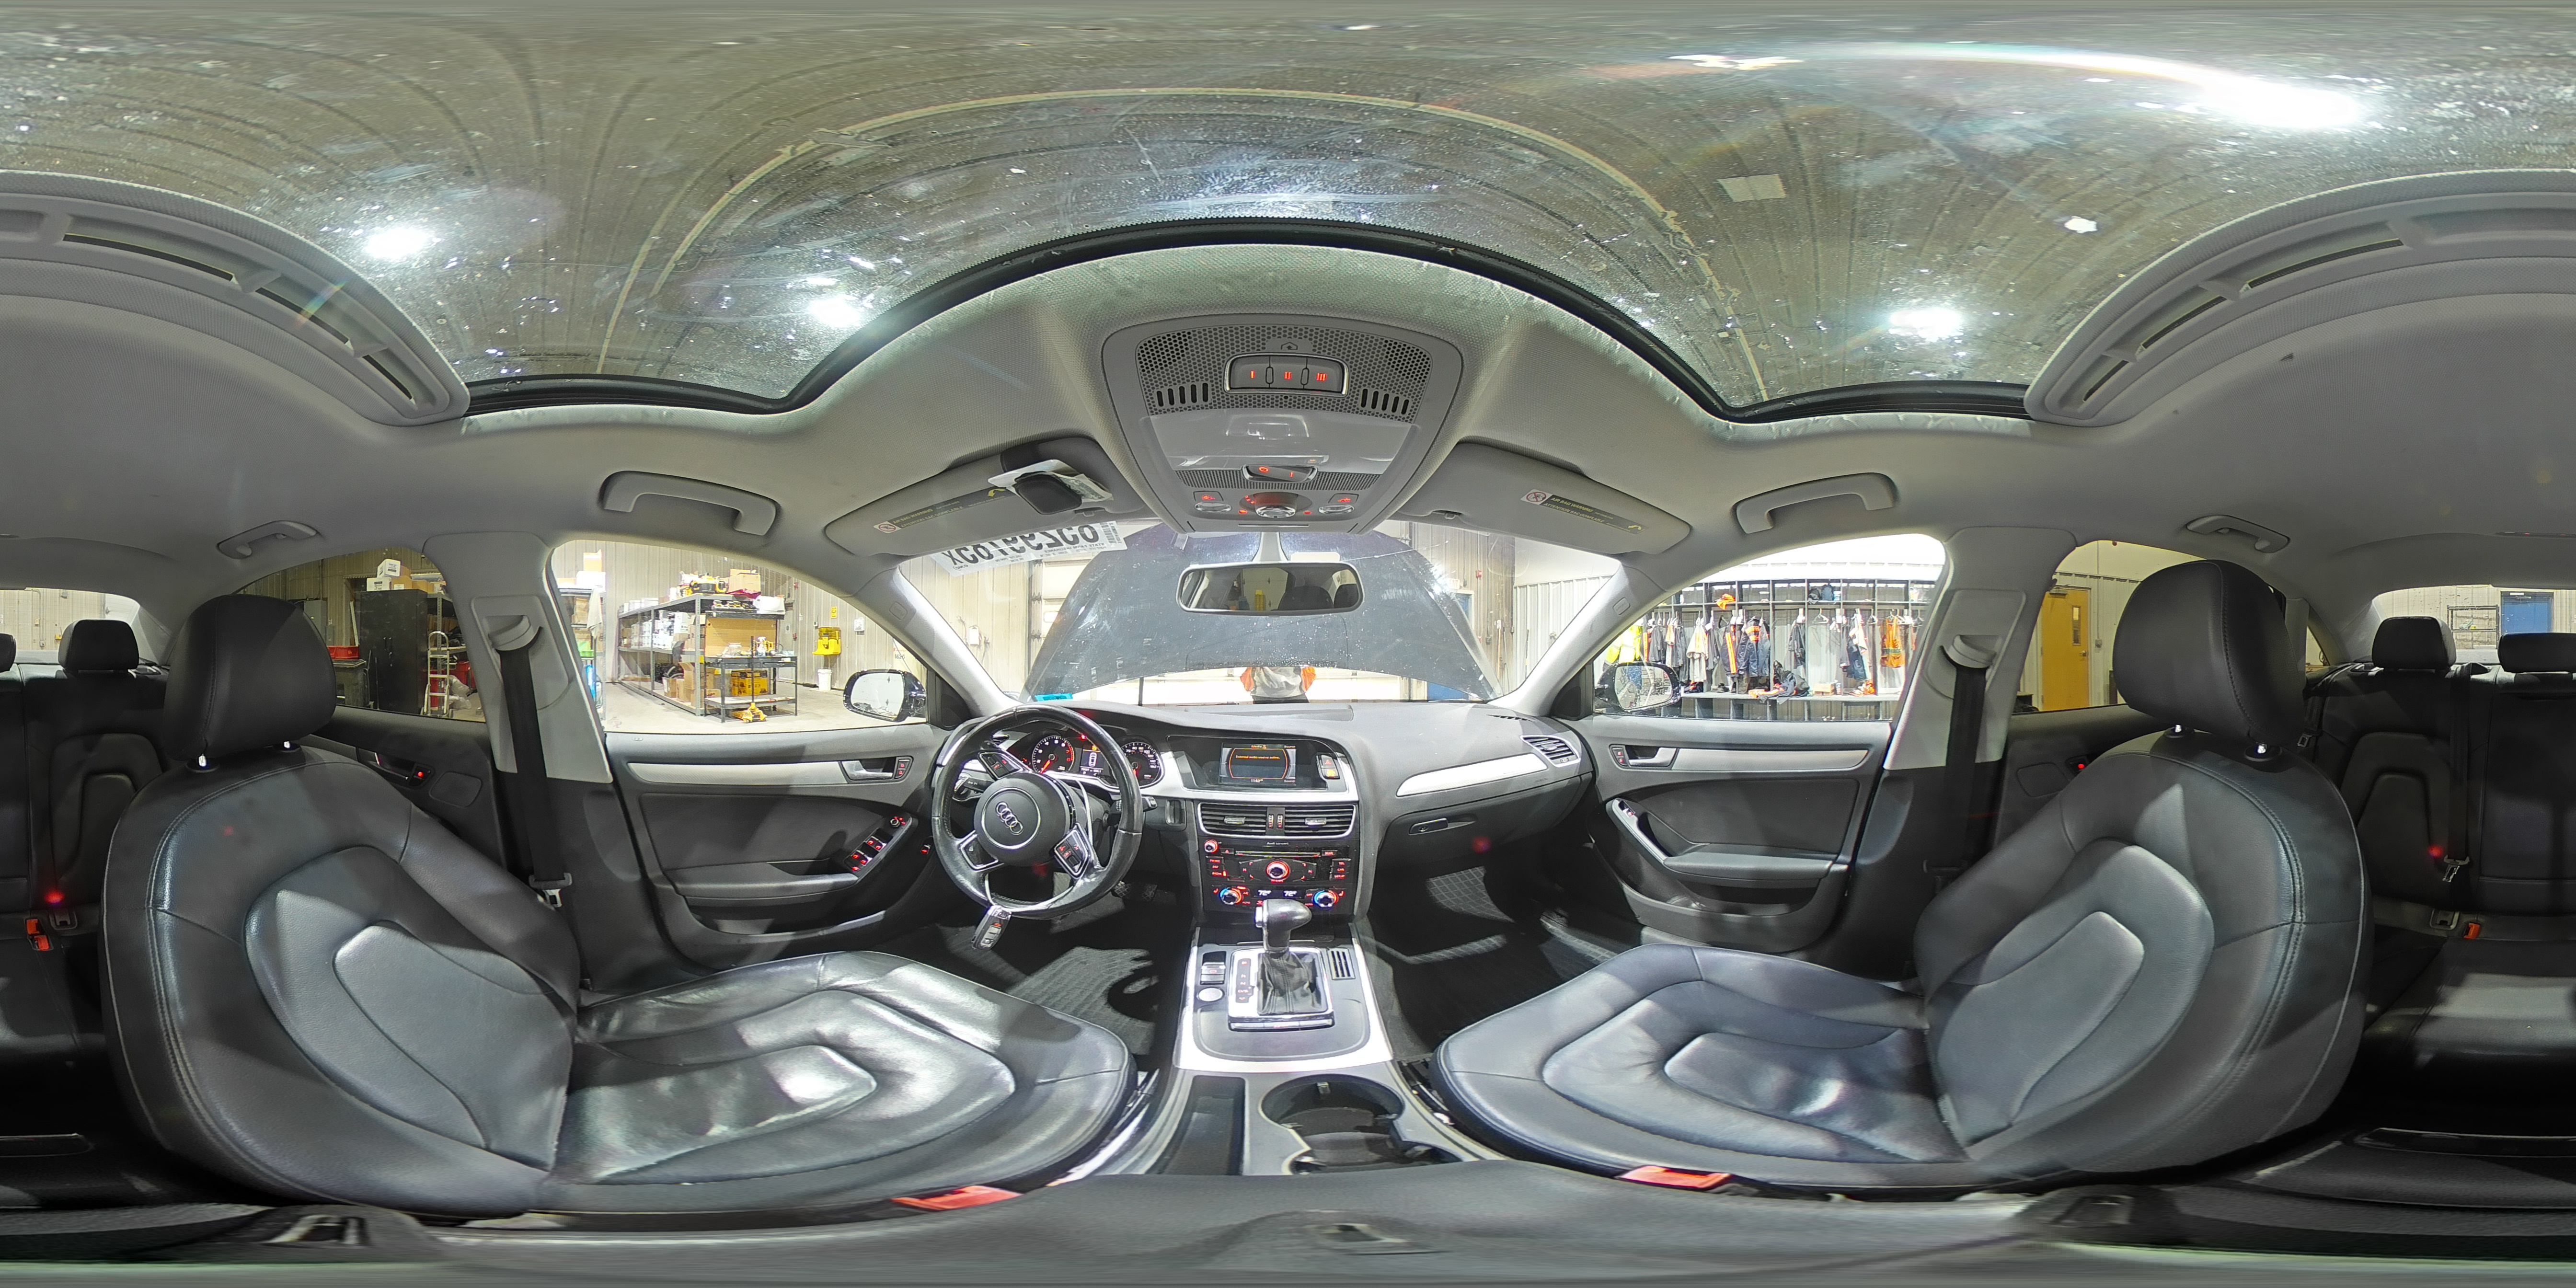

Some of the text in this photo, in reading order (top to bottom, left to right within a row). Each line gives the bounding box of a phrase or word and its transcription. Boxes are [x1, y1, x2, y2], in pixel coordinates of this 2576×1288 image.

[1543, 503, 1570, 512] ATTENTION
[1571, 503, 1593, 512] WARNING
[910, 508, 933, 518] WARNING
[901, 518, 925, 528] ATTENTION
